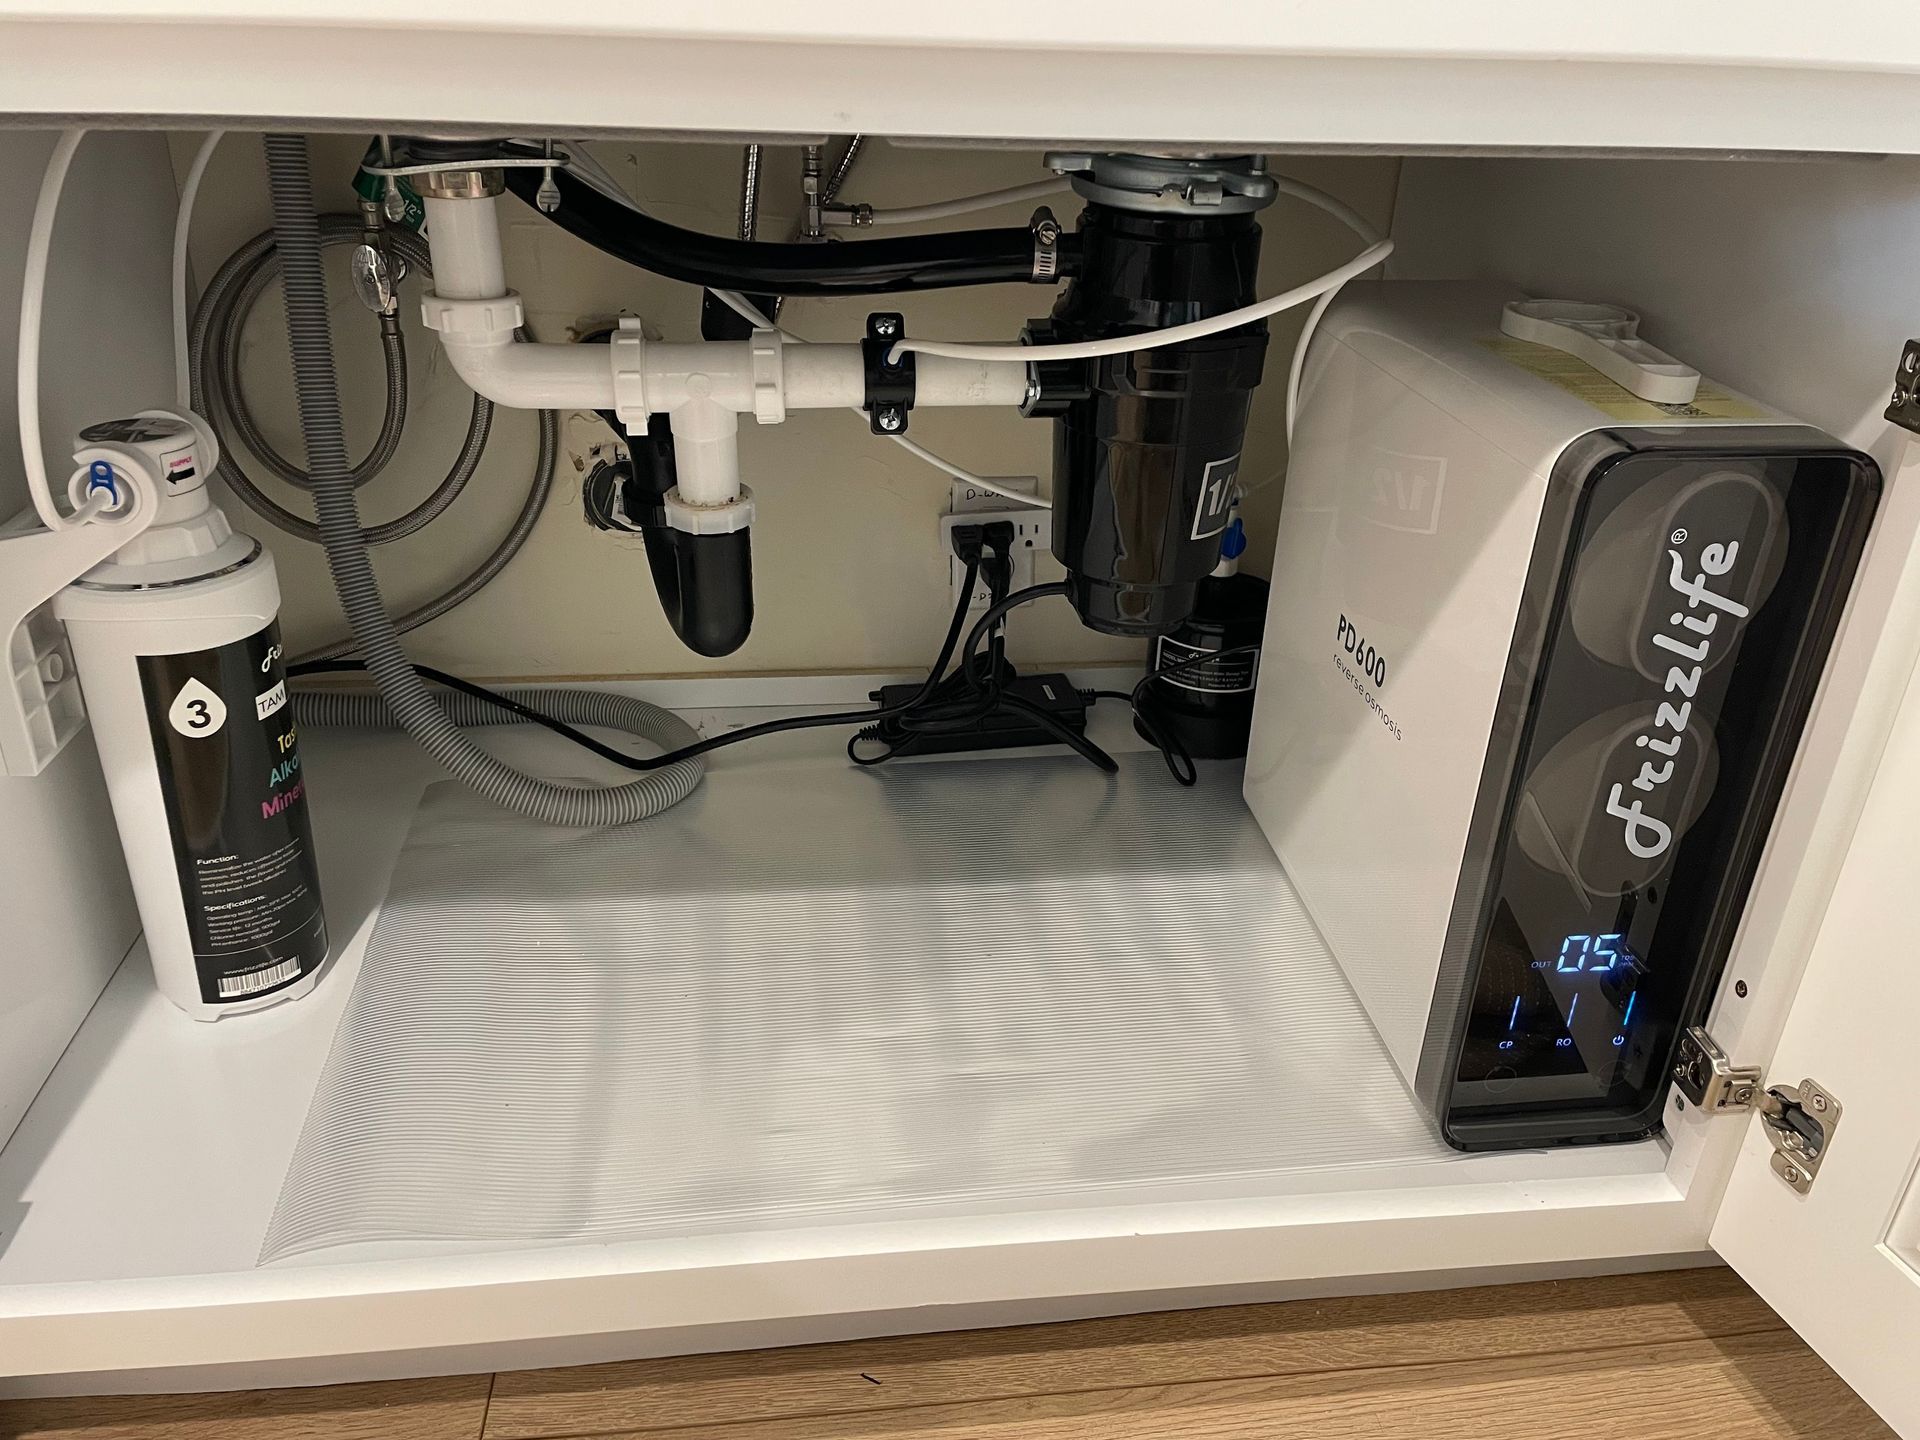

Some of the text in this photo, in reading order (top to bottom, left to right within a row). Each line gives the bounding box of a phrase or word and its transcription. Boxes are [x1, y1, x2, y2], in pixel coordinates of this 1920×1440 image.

[1337, 613, 1386, 688] PD600
[186, 699, 212, 729] 3
[1333, 654, 1402, 741] reverse osmosis
[1557, 934, 1621, 972] 05
[1499, 1038, 1572, 1049] CP RO
